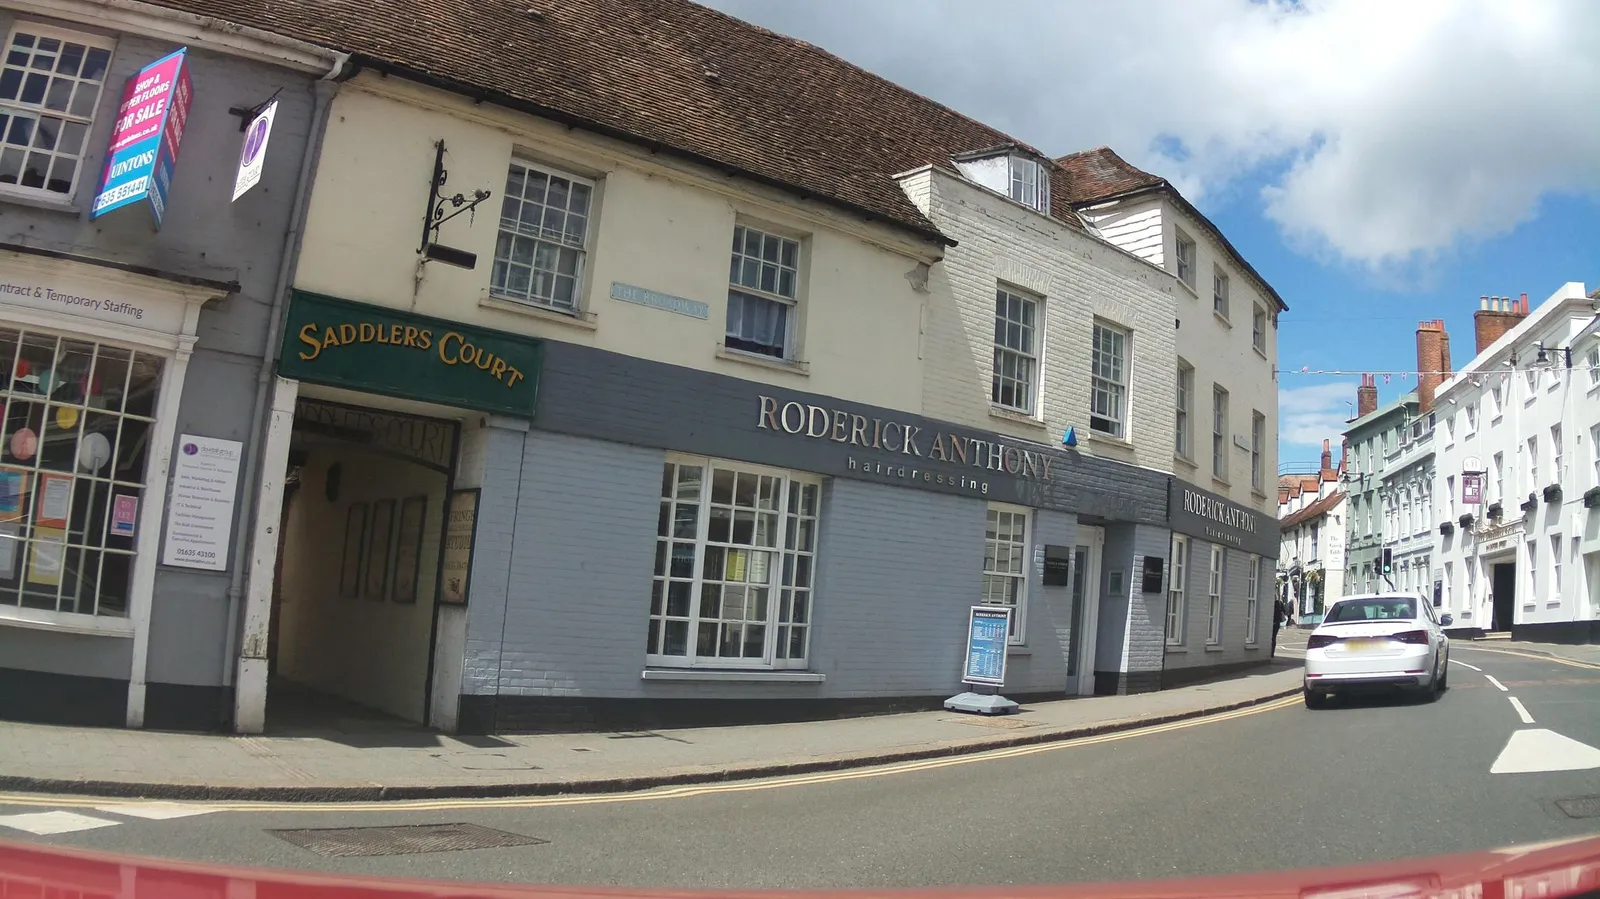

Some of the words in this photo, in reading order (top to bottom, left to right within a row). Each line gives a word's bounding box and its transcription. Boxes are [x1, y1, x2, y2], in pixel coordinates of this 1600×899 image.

[135, 76, 154, 93] SHOP
[154, 73, 161, 84] &
[142, 81, 170, 102] FLOORS
[114, 113, 135, 135] FOR
[135, 98, 165, 124] SALE
[117, 178, 147, 200] 551441
[33, 286, 42, 298] &
[46, 288, 101, 311] Temporary
[103, 299, 144, 319] Staffing
[616, 286, 637, 300] THE
[299, 323, 433, 360] SADDLERS
[438, 331, 524, 388] COURT
[757, 395, 923, 457] RODERICK
[927, 432, 1052, 480] ANTHONY
[848, 456, 989, 494] hairdressing
[1183, 489, 1225, 523] RODERICK
[1224, 506, 1258, 534] ANTHONY
[177, 548, 196, 557] 01635
[196, 550, 216, 559] 43100
